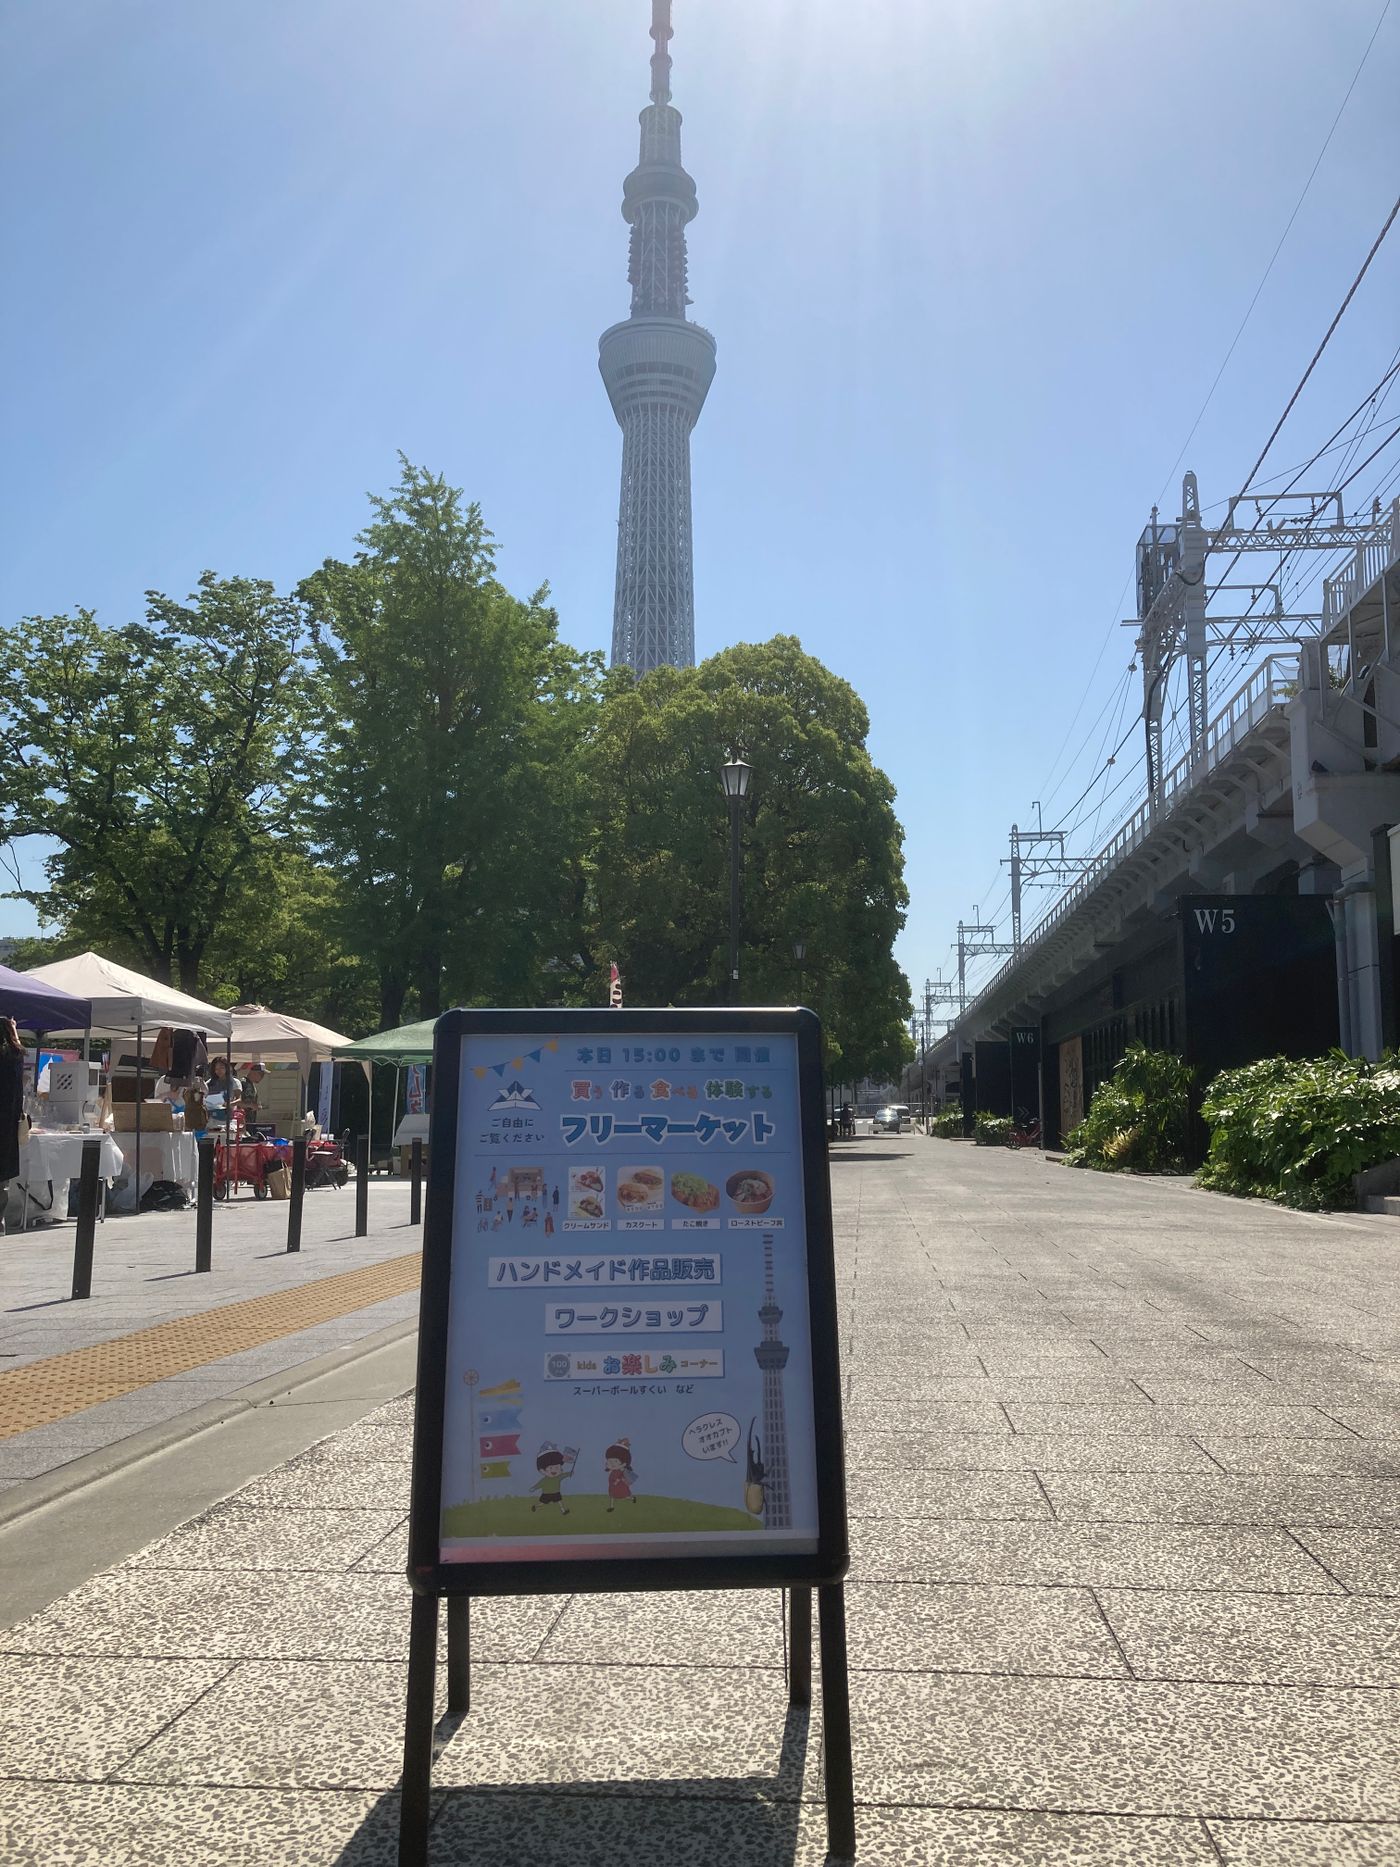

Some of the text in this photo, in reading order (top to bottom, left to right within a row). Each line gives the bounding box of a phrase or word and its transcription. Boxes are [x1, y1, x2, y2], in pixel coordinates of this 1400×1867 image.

[1193, 909, 1235, 934] W5
[1016, 1032, 1034, 1044] W6
[577, 1047, 612, 1064] 本日
[622, 1048, 681, 1064] 15:00
[690, 1047, 725, 1063] まで
[571, 1078, 773, 1101] 買う 作る 食べる 体験する
[491, 1117, 534, 1128] ご自由に
[561, 1111, 775, 1144] フリーマーケット
[480, 1133, 545, 1145] ご覧ください
[496, 1257, 716, 1282] ハンドメイド作品販売
[554, 1303, 710, 1329] ワークショップ
[551, 1360, 568, 1369] 100
[576, 1360, 597, 1371] kids
[573, 1384, 695, 1396] スーパーボールすくい など
